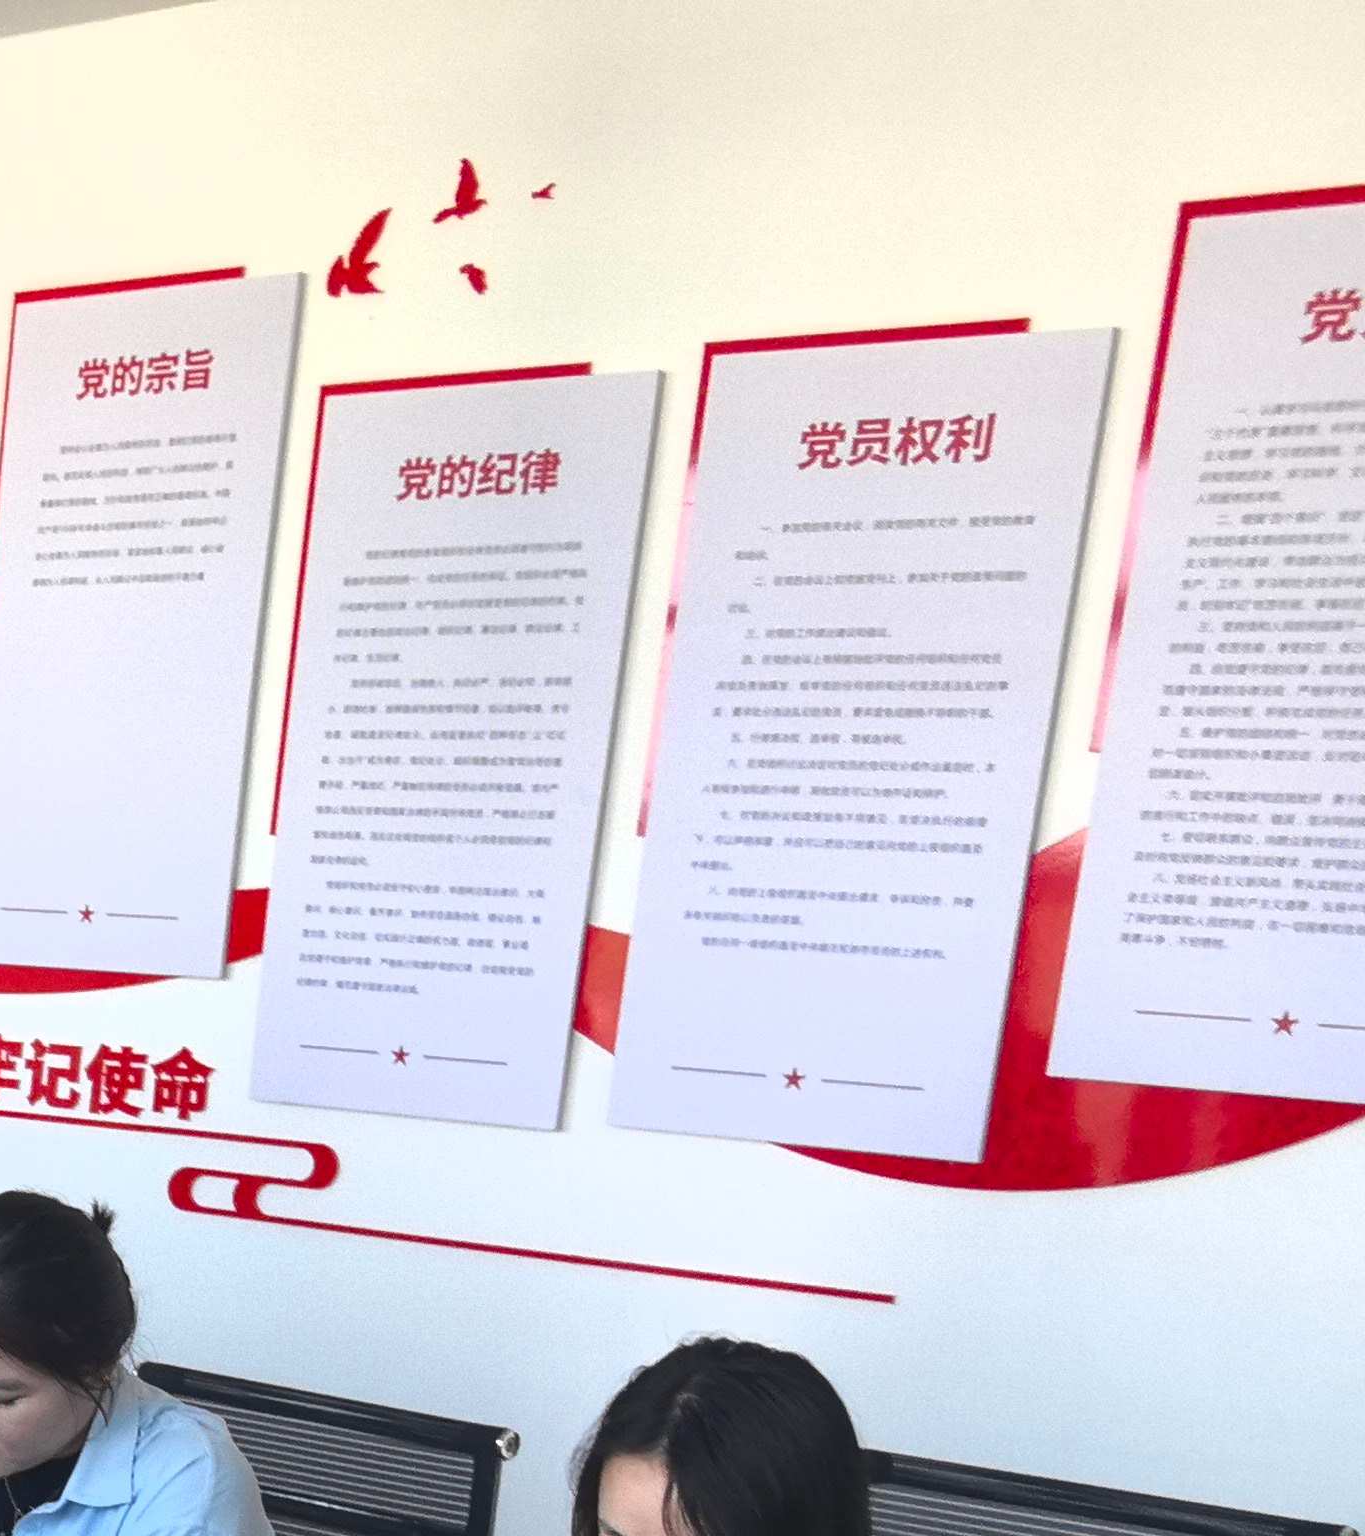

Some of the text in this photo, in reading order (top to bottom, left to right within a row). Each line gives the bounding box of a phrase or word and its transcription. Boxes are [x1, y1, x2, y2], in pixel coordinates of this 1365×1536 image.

[1299, 288, 1365, 345] 党
[75, 347, 215, 401] 党的宗旨
[797, 411, 998, 470] 党员权利
[396, 448, 563, 501] 党的纪律
